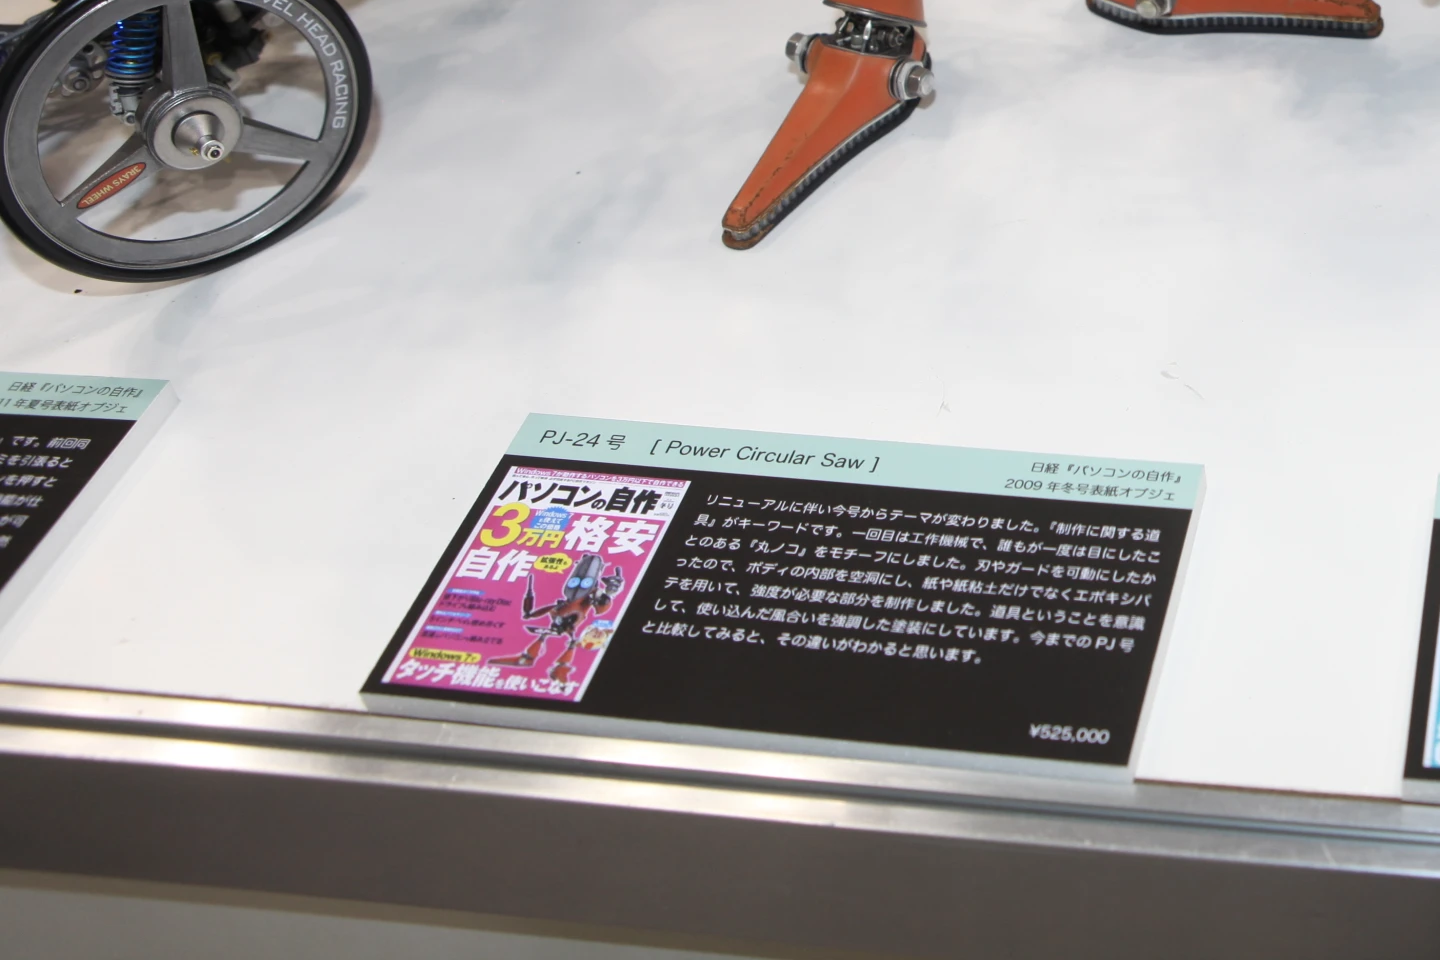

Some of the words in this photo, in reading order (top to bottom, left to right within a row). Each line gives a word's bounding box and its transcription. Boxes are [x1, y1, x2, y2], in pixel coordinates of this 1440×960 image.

[296, 12, 337, 57] HEAD
[330, 59, 349, 129] RACING
[112, 166, 141, 187] 3RAYS
[82, 185, 114, 205] WHEEL
[8, 381, 143, 398] 日経『パソコンの自作』
[0, 436, 92, 450] です。前回同
[539, 429, 601, 448] PJ-24
[606, 433, 627, 451] 号
[665, 440, 731, 458] Power
[736, 445, 815, 466] Circular
[821, 452, 865, 470] Saw
[516, 467, 551, 477] Windows
[1031, 461, 1183, 484] 日経『パソコンの自作』
[498, 481, 662, 515] パソコンの自作
[1004, 478, 1044, 491] 2009
[1047, 481, 1177, 502] 年冬号表紙オブジェ
[455, 547, 538, 582] 自作
[412, 647, 462, 662] Windows
[1029, 723, 1110, 744] ¥525,000
